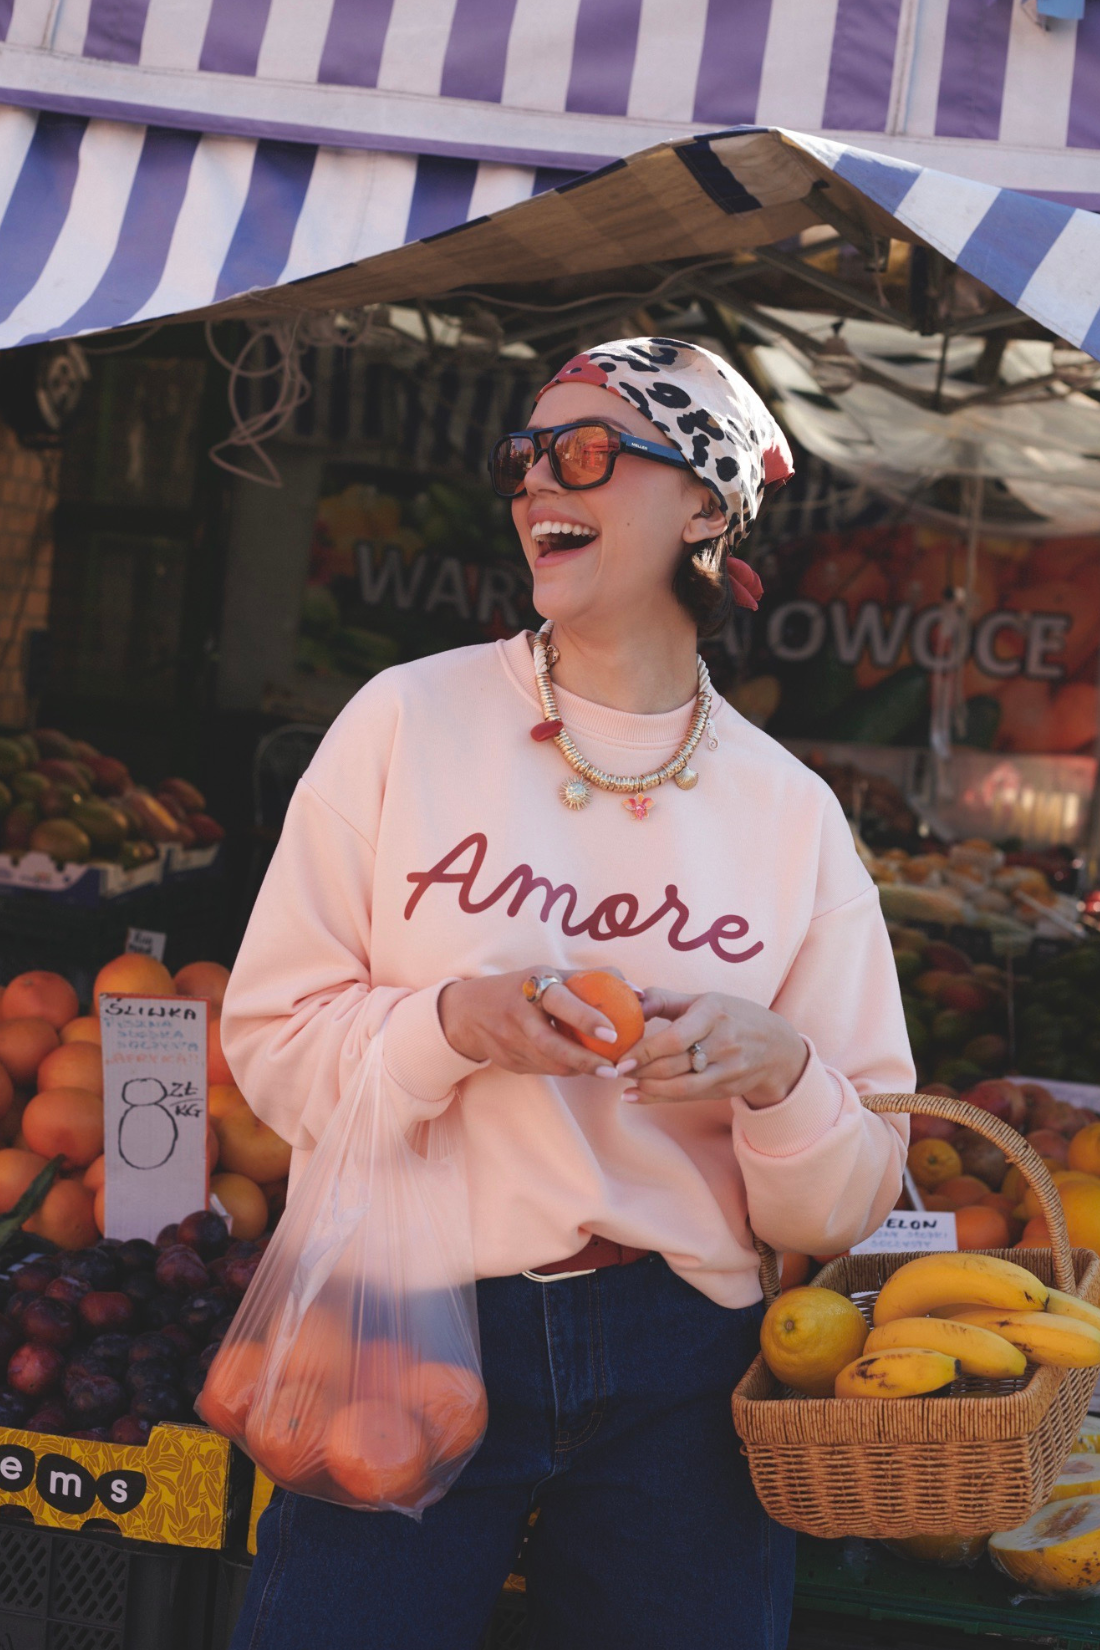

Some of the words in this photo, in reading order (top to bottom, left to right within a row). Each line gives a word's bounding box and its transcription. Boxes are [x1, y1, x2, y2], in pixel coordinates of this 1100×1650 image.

[767, 599, 1070, 678] OWOCE
[404, 832, 764, 963] Amore
[105, 998, 197, 1020] ŚLIWKA
[118, 1077, 179, 1170] 8
[880, 1218, 938, 1231] ELON
[0, 1456, 128, 1503] ems
